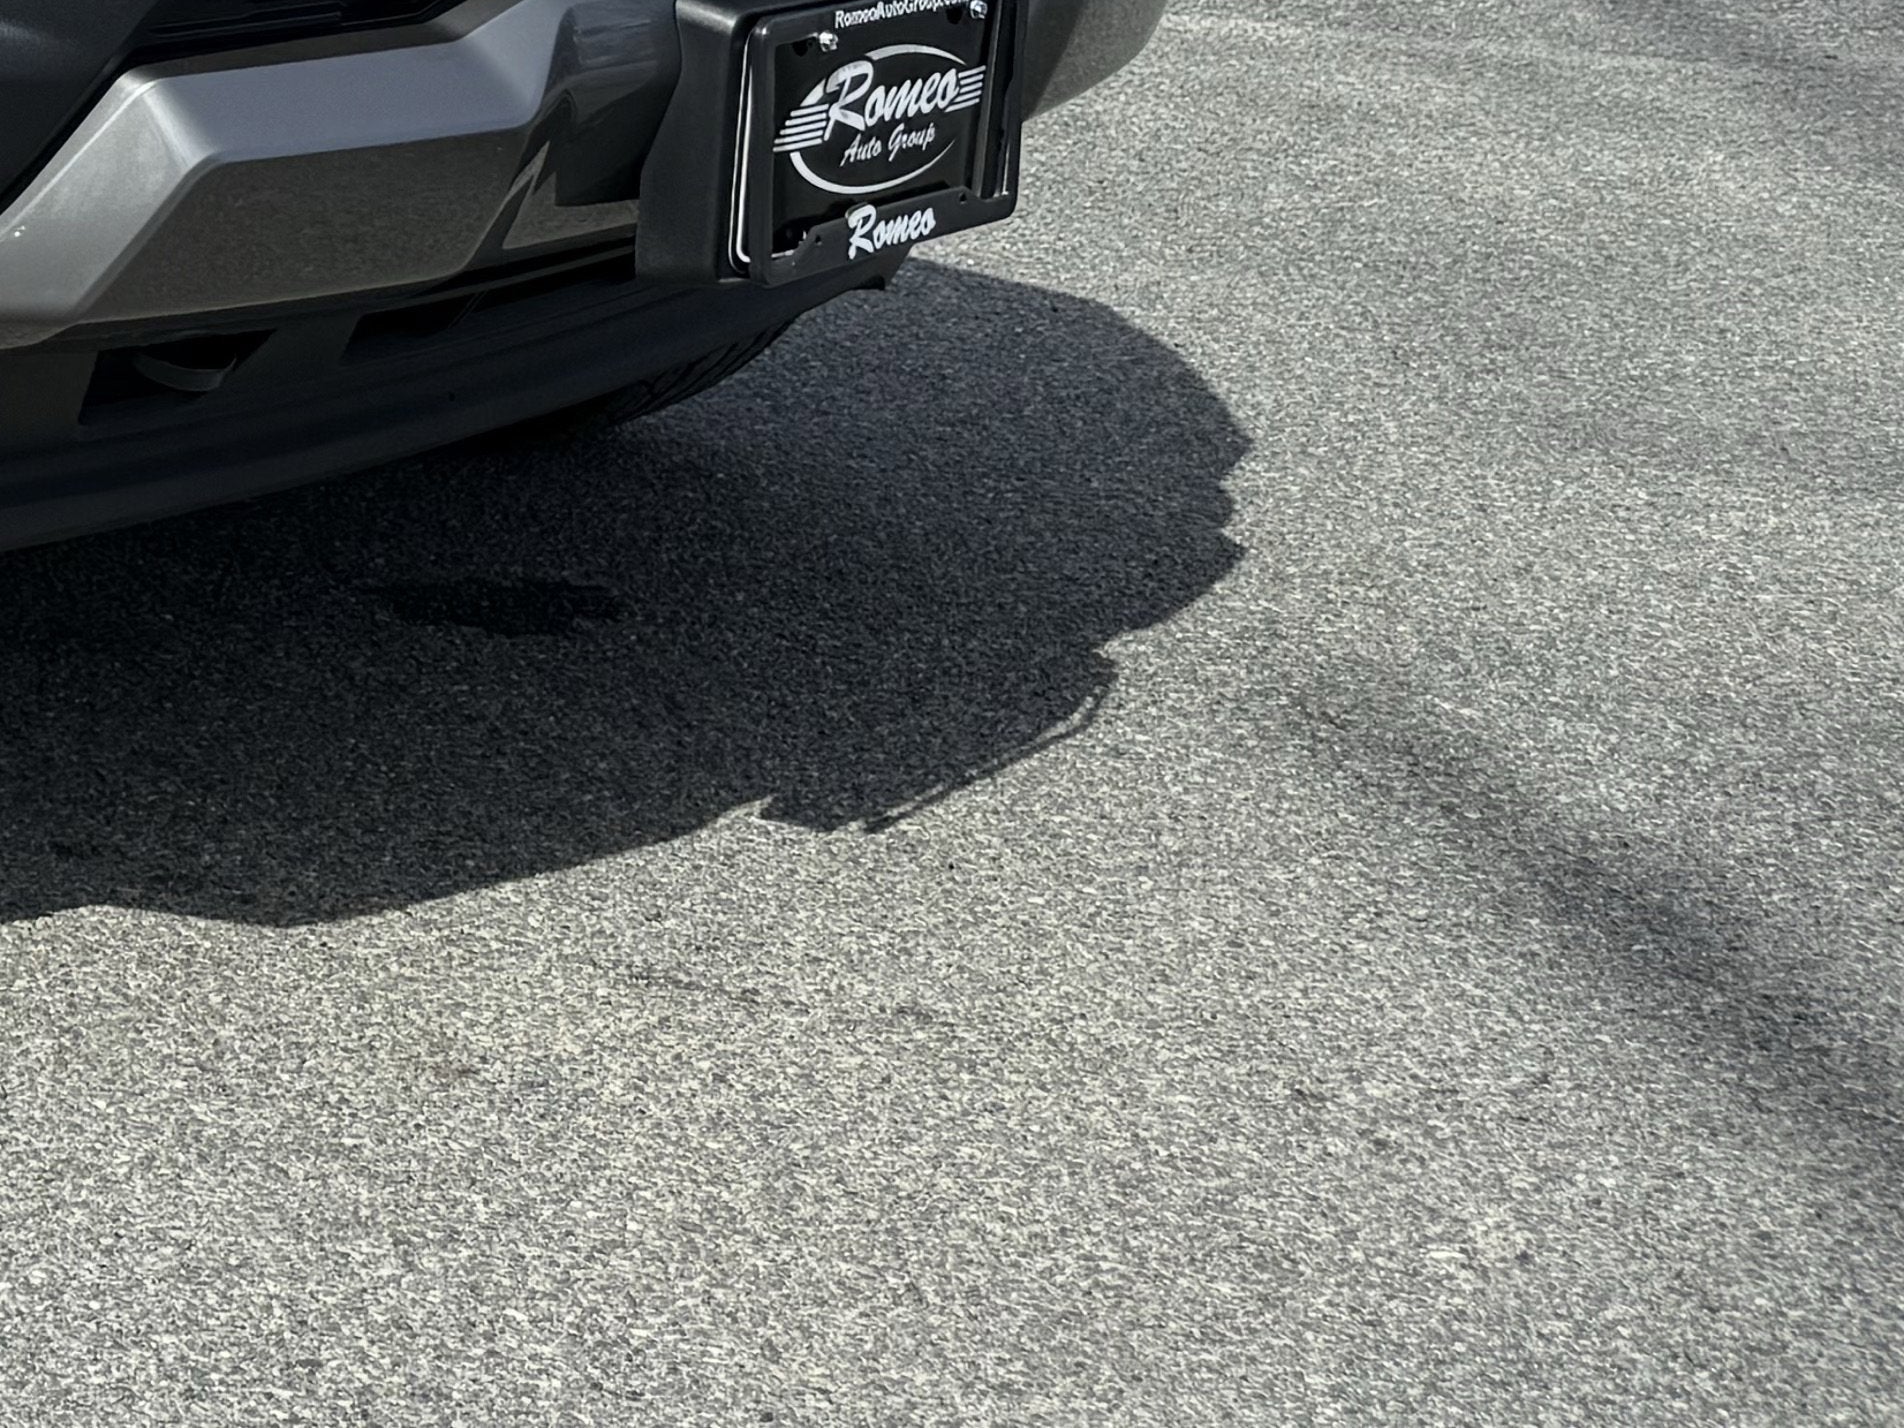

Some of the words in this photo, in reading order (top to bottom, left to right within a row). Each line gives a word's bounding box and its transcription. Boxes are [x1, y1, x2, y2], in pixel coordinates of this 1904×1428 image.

[824, 60, 959, 141] Romeo
[839, 134, 882, 167] Auto
[888, 121, 936, 163] Group
[845, 202, 936, 259] Romeo
